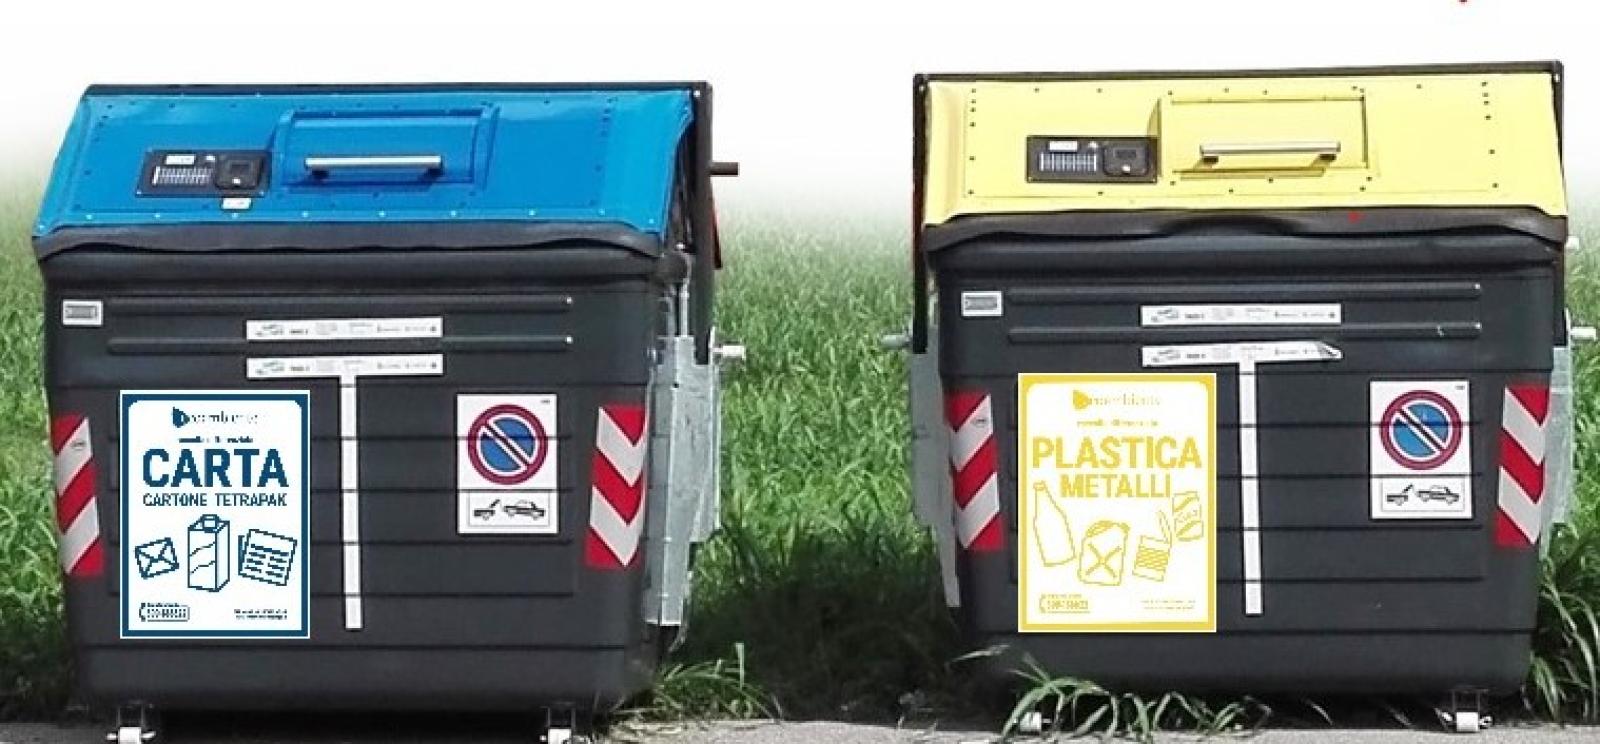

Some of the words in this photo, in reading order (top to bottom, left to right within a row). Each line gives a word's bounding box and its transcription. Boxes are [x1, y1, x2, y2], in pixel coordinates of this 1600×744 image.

[1032, 436, 1202, 469] PLASTICA
[143, 448, 289, 488] CARTA
[142, 493, 208, 507] CARTONE
[214, 493, 288, 507] TETRAPAK
[1060, 474, 1171, 498] METALLI
